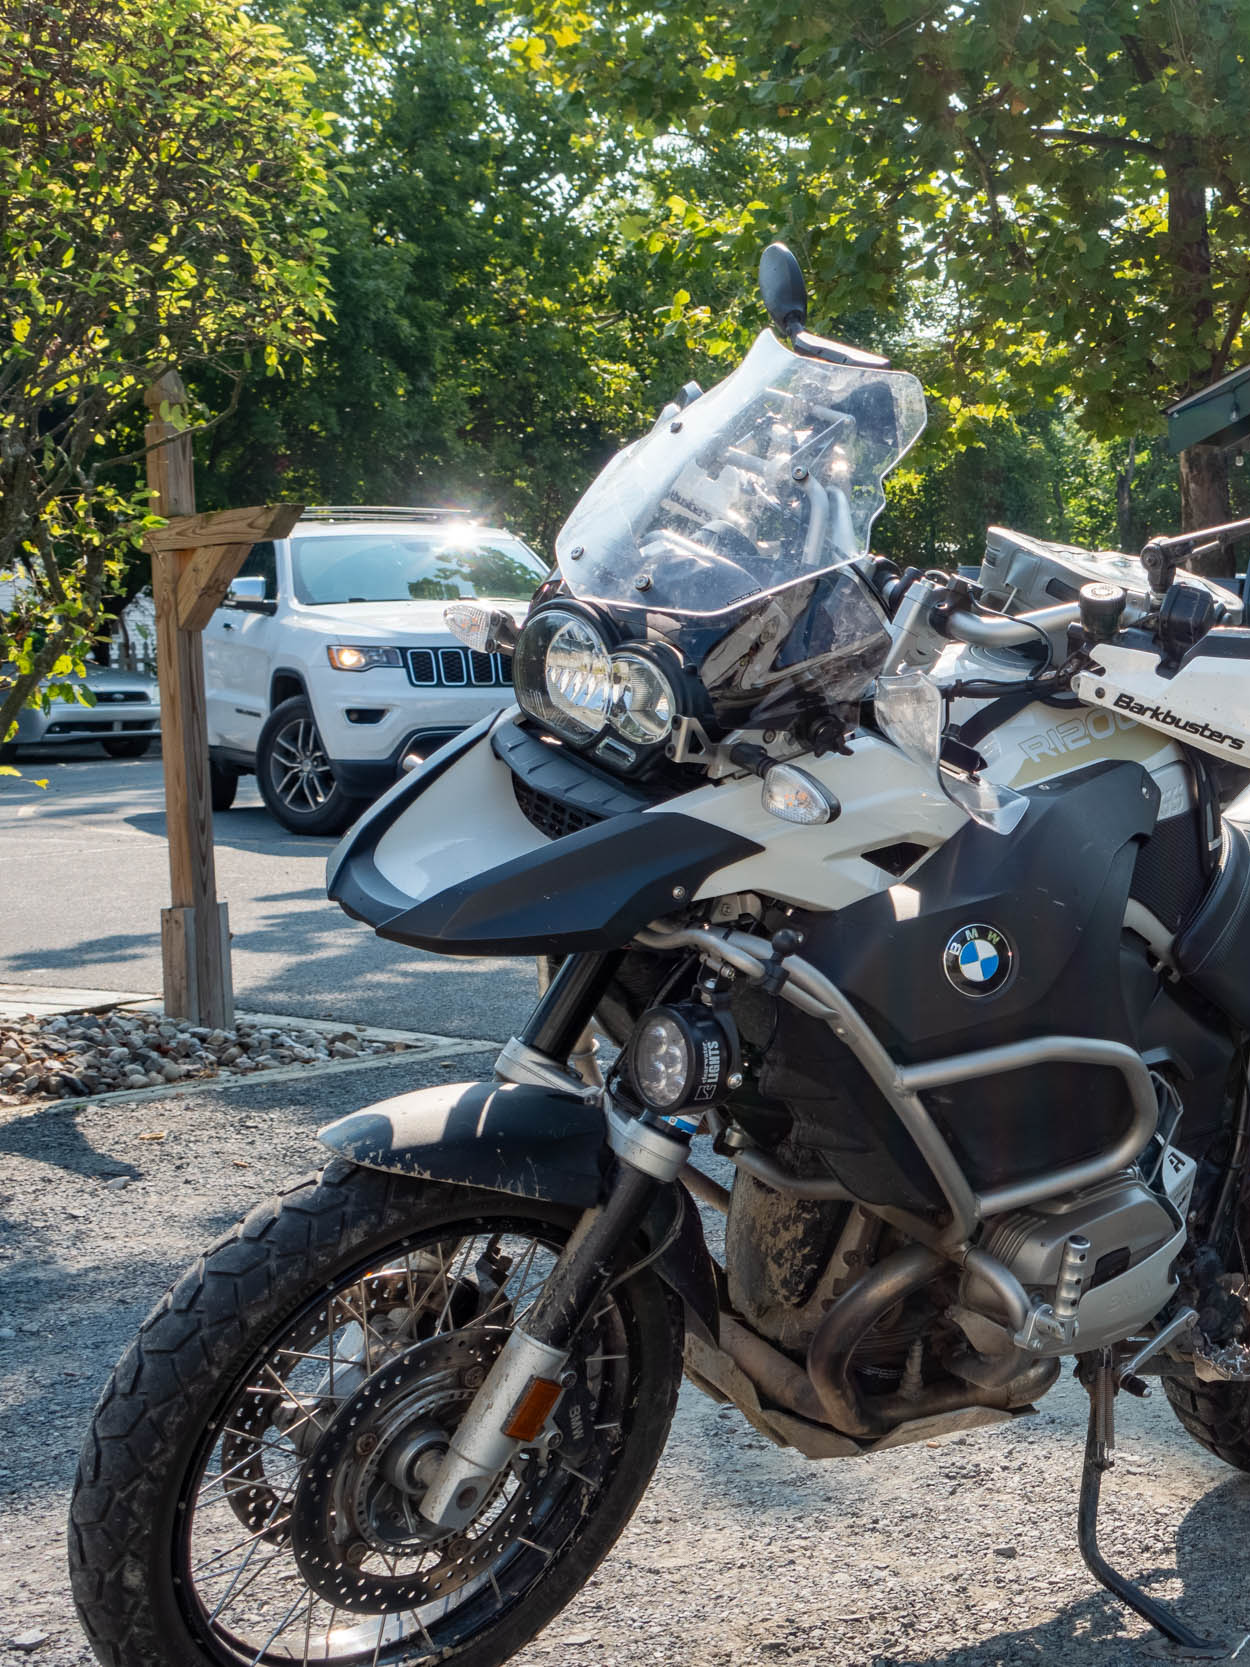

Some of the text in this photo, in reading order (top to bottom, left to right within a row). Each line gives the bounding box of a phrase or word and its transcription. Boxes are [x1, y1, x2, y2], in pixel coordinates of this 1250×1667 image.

[1113, 693, 1245, 750] Barkbusters
[948, 927, 1001, 956] BMW
[707, 1041, 721, 1084] LIGHTS
[569, 1405, 585, 1440] BMW
